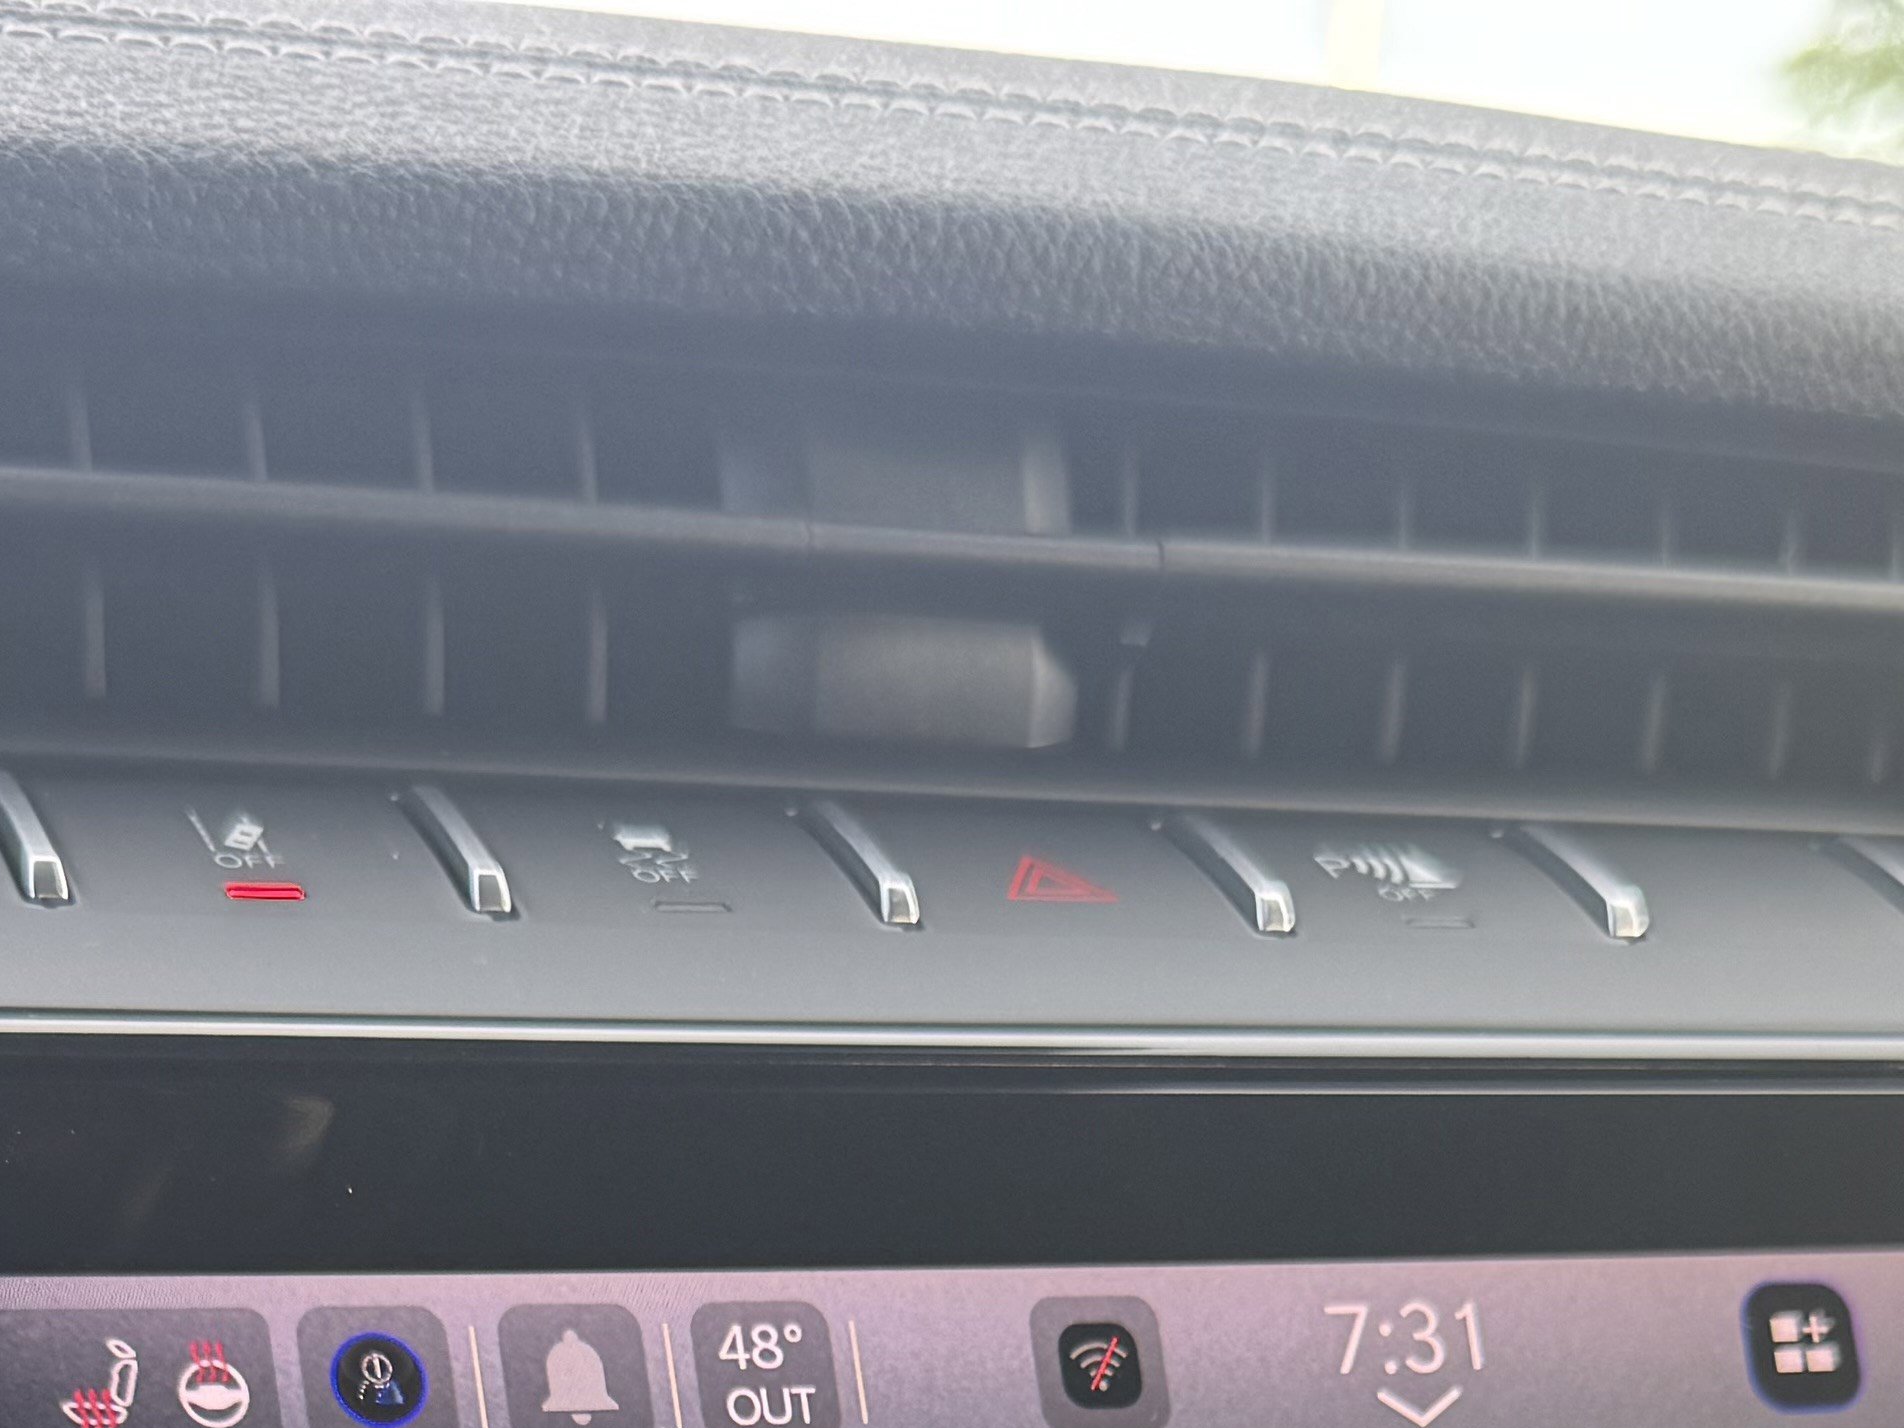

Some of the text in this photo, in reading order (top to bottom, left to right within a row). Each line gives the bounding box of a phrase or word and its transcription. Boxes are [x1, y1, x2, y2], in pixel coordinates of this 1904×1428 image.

[717, 1323, 803, 1370] 48°
[1322, 1297, 1489, 1378] 7:31
[725, 1384, 817, 1427] OUT
